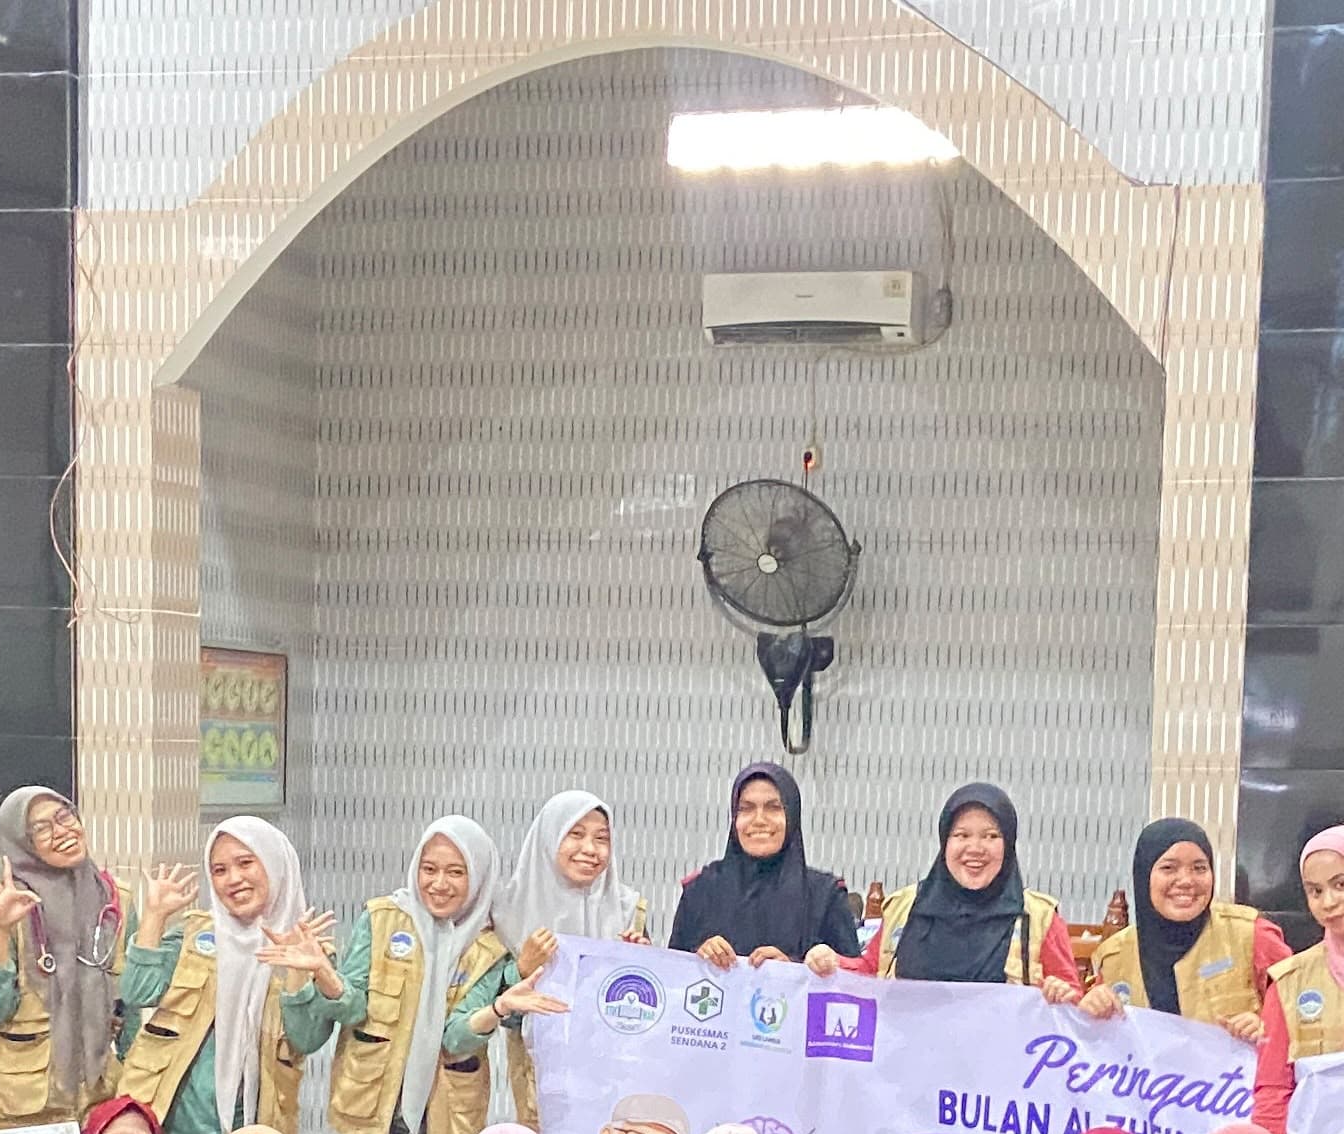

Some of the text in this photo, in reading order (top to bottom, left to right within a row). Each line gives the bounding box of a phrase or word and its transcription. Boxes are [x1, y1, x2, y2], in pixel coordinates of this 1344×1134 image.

[671, 1025, 729, 1040] PUSKESMAS
[670, 1036, 719, 1049] SENDANA
[720, 1041, 727, 1051] 2
